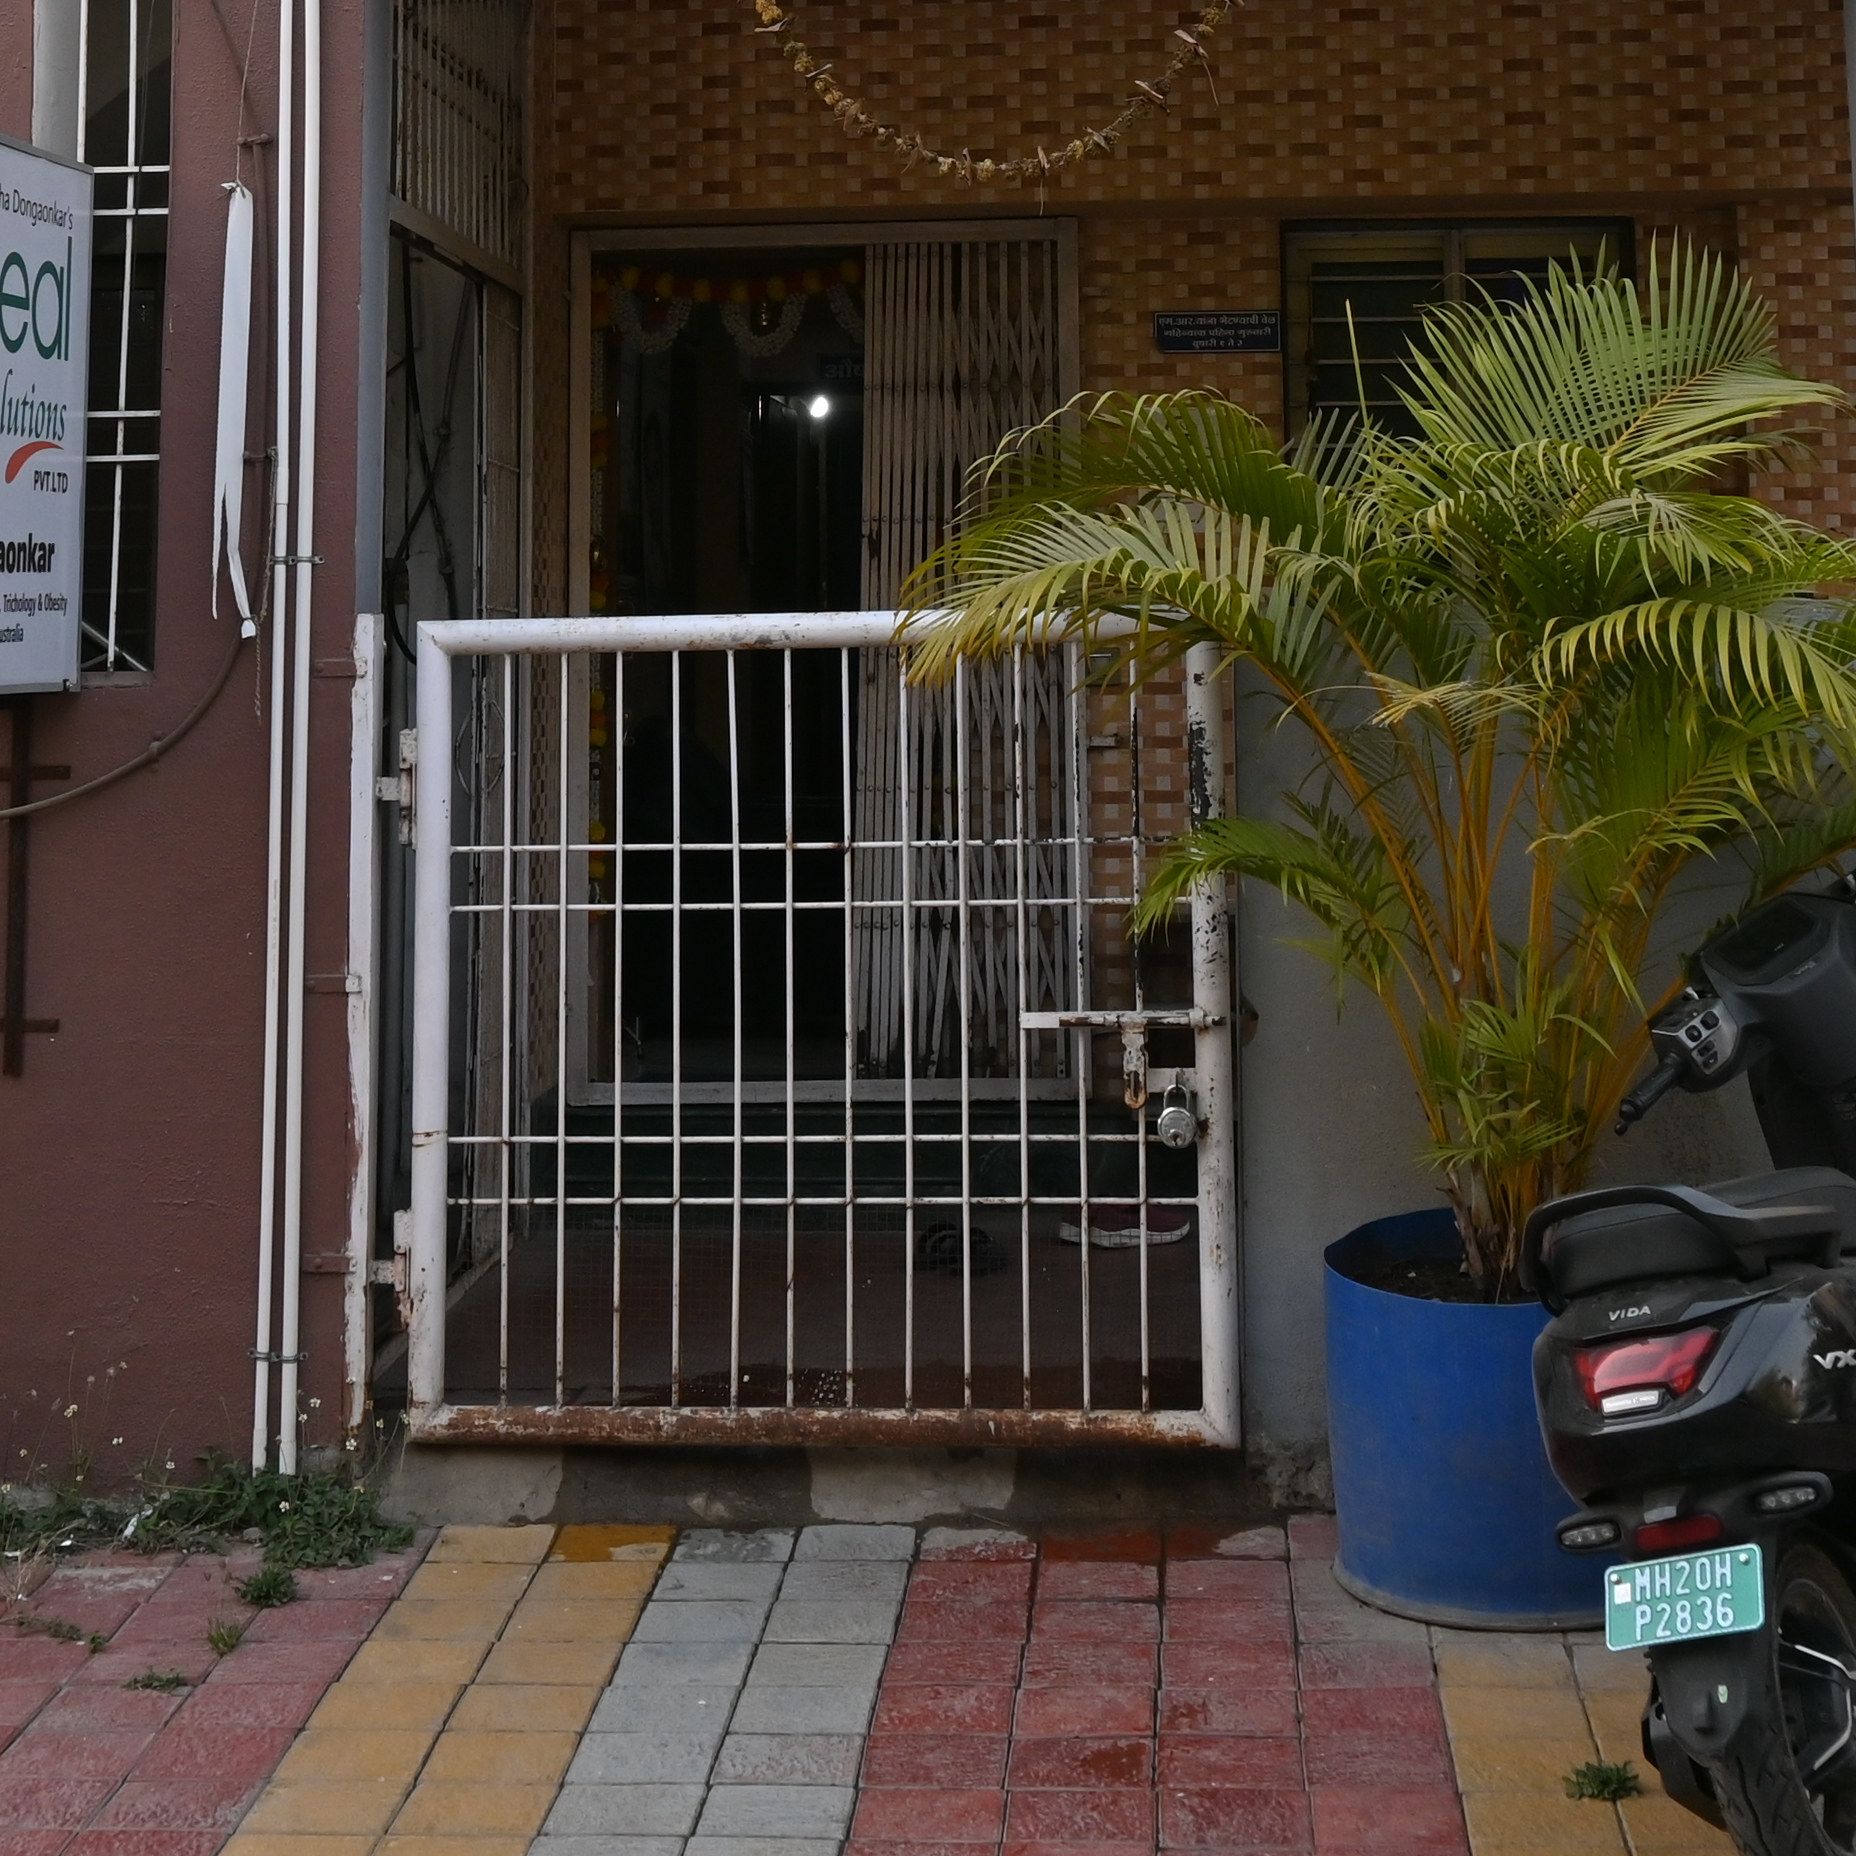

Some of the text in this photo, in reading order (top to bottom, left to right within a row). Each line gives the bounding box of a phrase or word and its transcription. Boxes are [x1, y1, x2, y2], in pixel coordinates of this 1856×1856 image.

[1608, 1306, 1651, 1321] VIDA
[1635, 1553, 1732, 1602] MH20H
[1636, 1592, 1734, 1641] P2836
